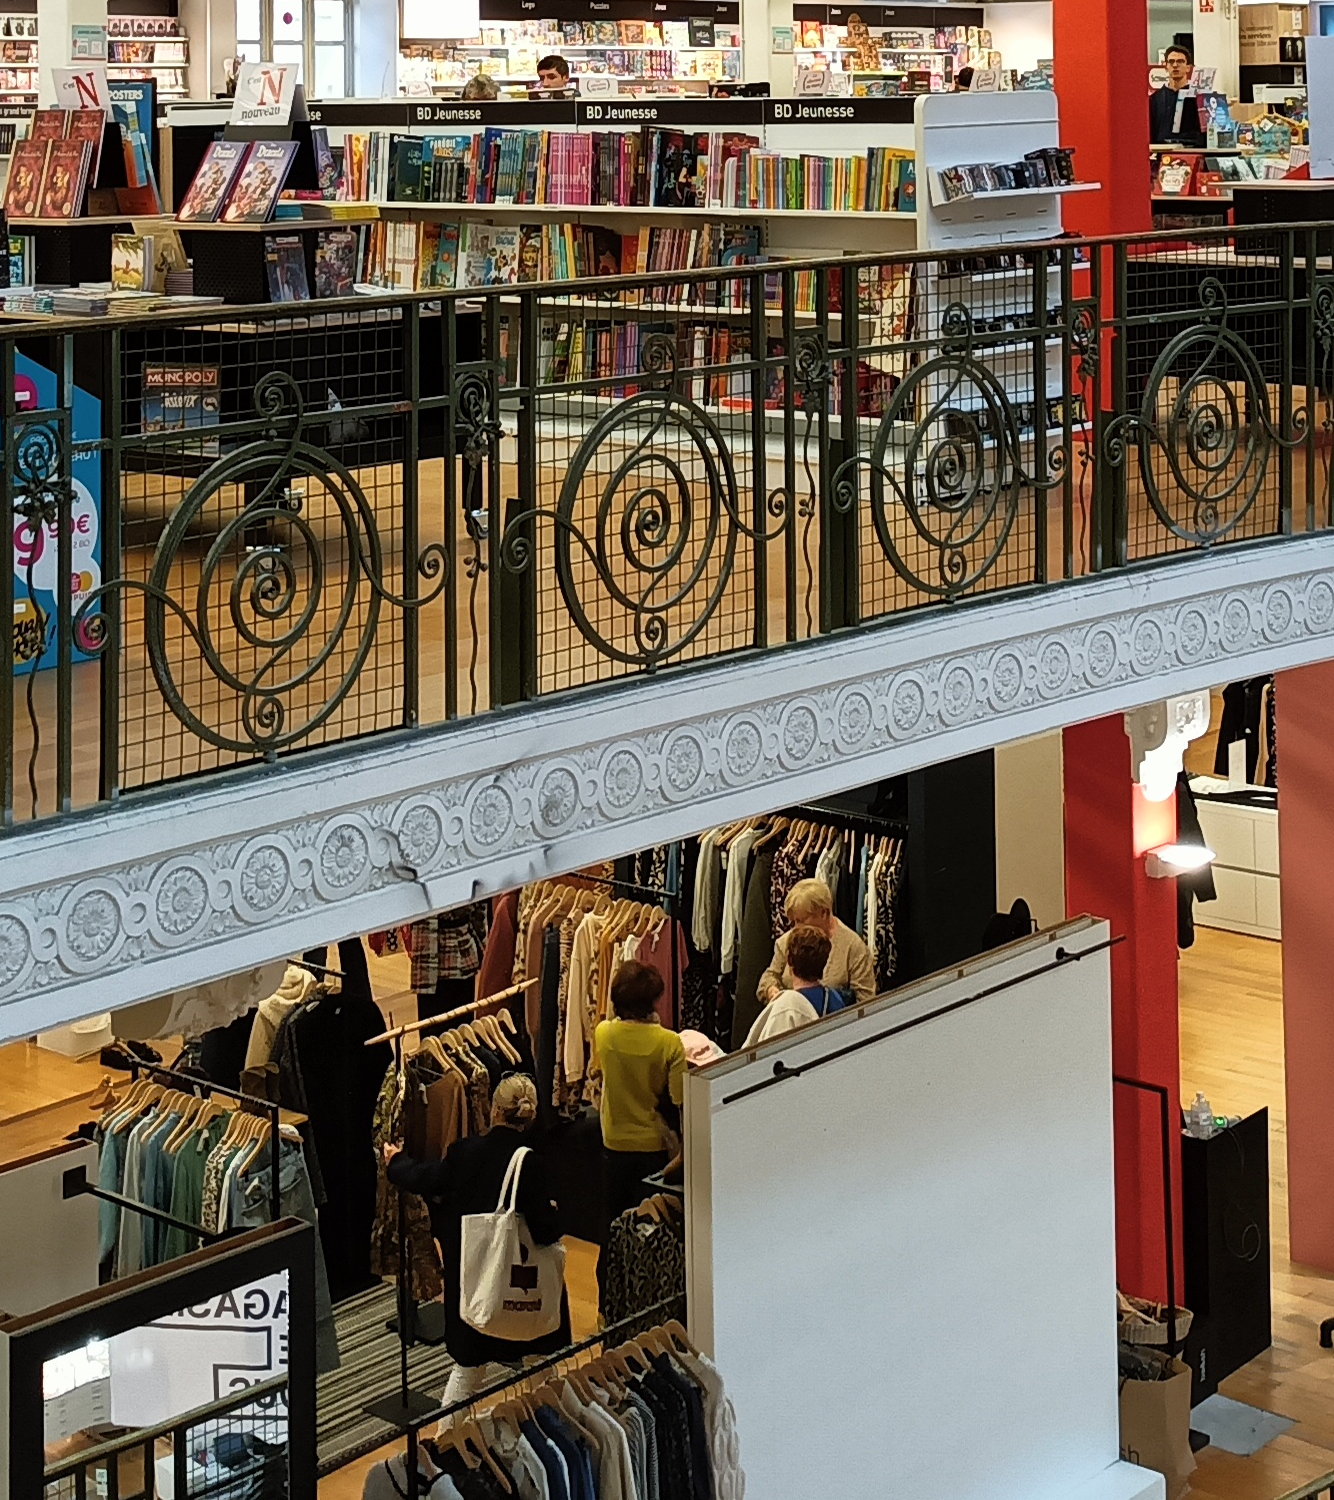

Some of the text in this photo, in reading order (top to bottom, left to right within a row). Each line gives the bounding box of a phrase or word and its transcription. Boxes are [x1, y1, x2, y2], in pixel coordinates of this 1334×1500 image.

[71, 72, 101, 109] N
[256, 67, 287, 106] N
[107, 89, 144, 100] POSTERS
[241, 105, 281, 120] nouveau
[416, 106, 482, 120] BD Jeunesse
[586, 105, 658, 120] BD Jeunesse
[774, 103, 855, 119] BD Jeunesse
